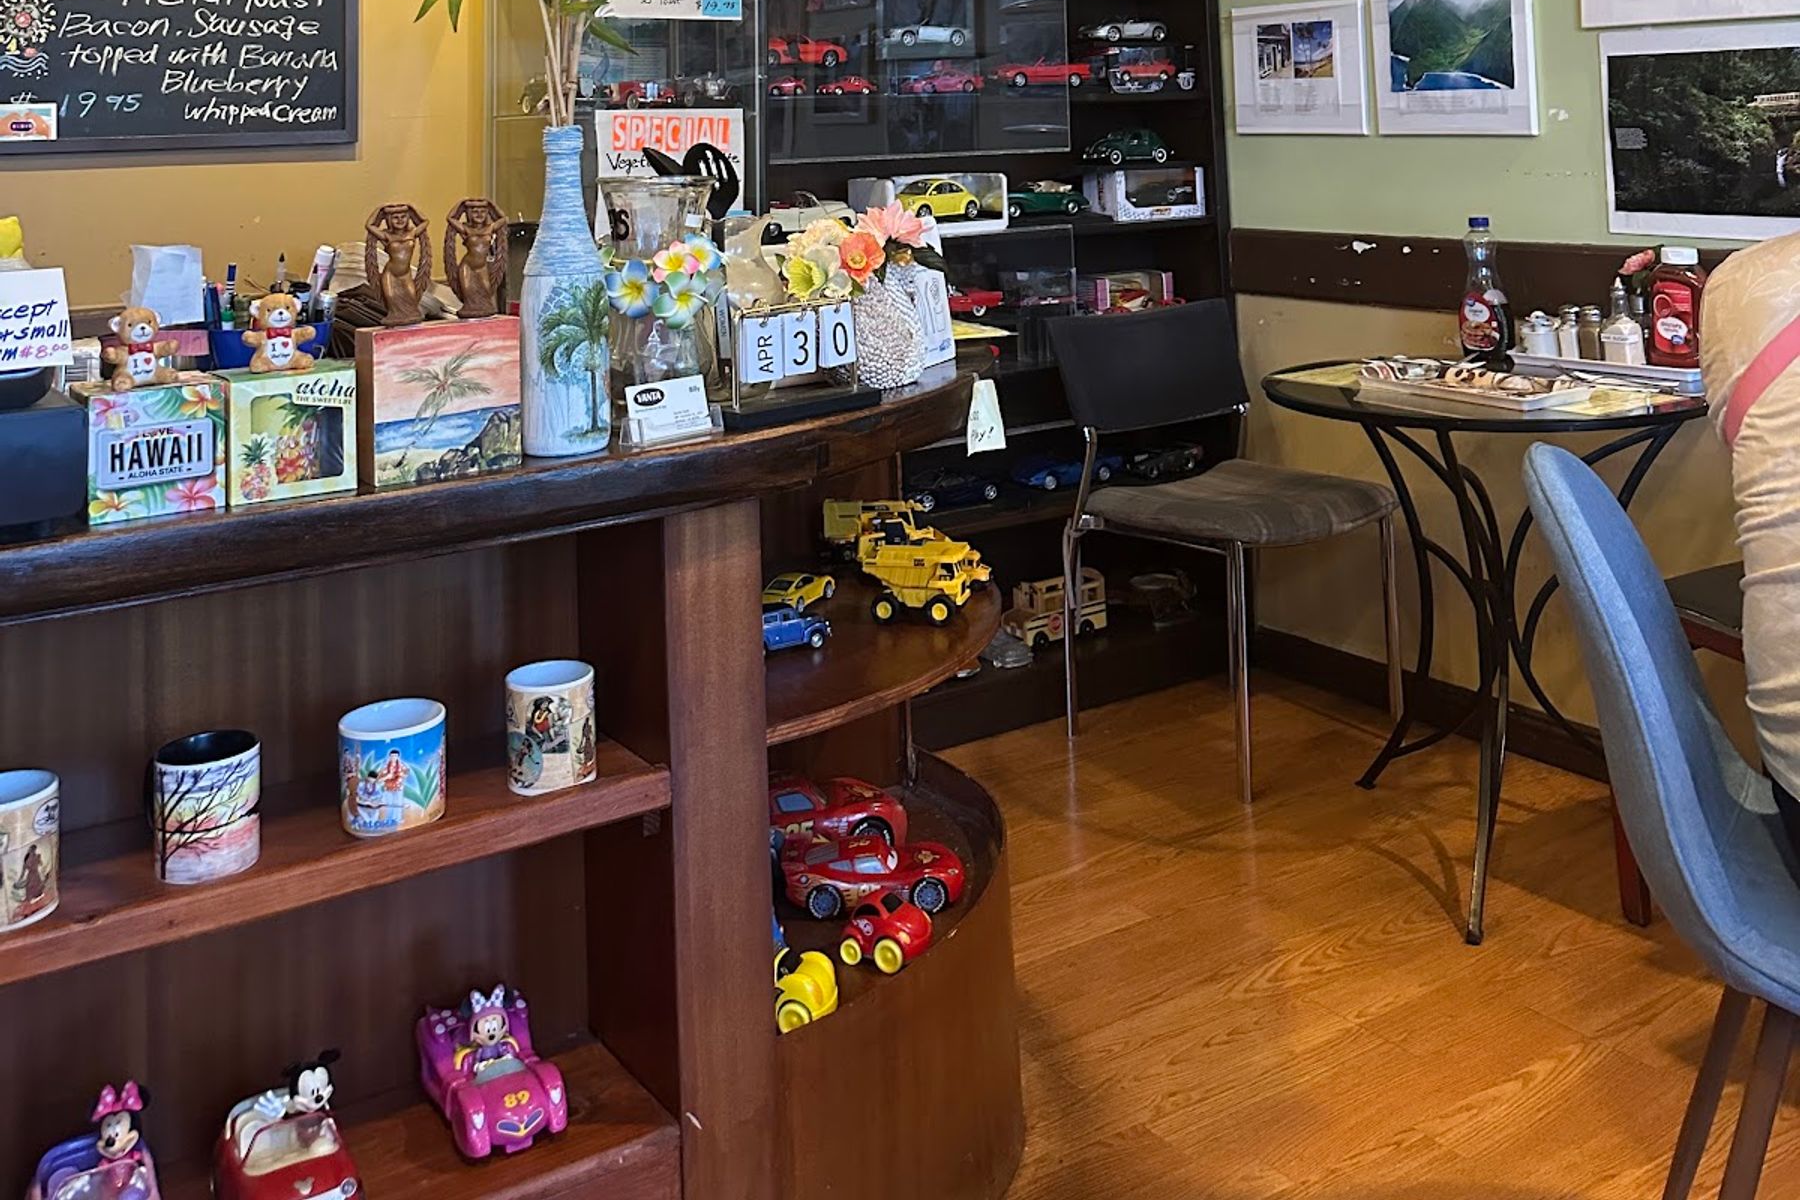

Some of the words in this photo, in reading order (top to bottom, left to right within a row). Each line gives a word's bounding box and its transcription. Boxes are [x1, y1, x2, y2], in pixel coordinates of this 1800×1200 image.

[186, 7, 321, 41] Sausage
[60, 43, 159, 77] topped
[168, 41, 228, 67] with
[239, 44, 339, 73] Banana
[160, 68, 309, 101] Blueberry
[184, 97, 271, 125] whipped
[612, 114, 731, 152] SPECIAL
[14, 319, 68, 340] small
[757, 334, 774, 374] APR
[792, 330, 809, 366] 3
[832, 322, 849, 357] 0
[296, 378, 355, 398] aloha
[636, 390, 662, 403] VANTA
[110, 433, 203, 474] HAWAII
[128, 469, 157, 479] ALOHA
[158, 466, 184, 476] STATE
[503, 1090, 530, 1109] 89
